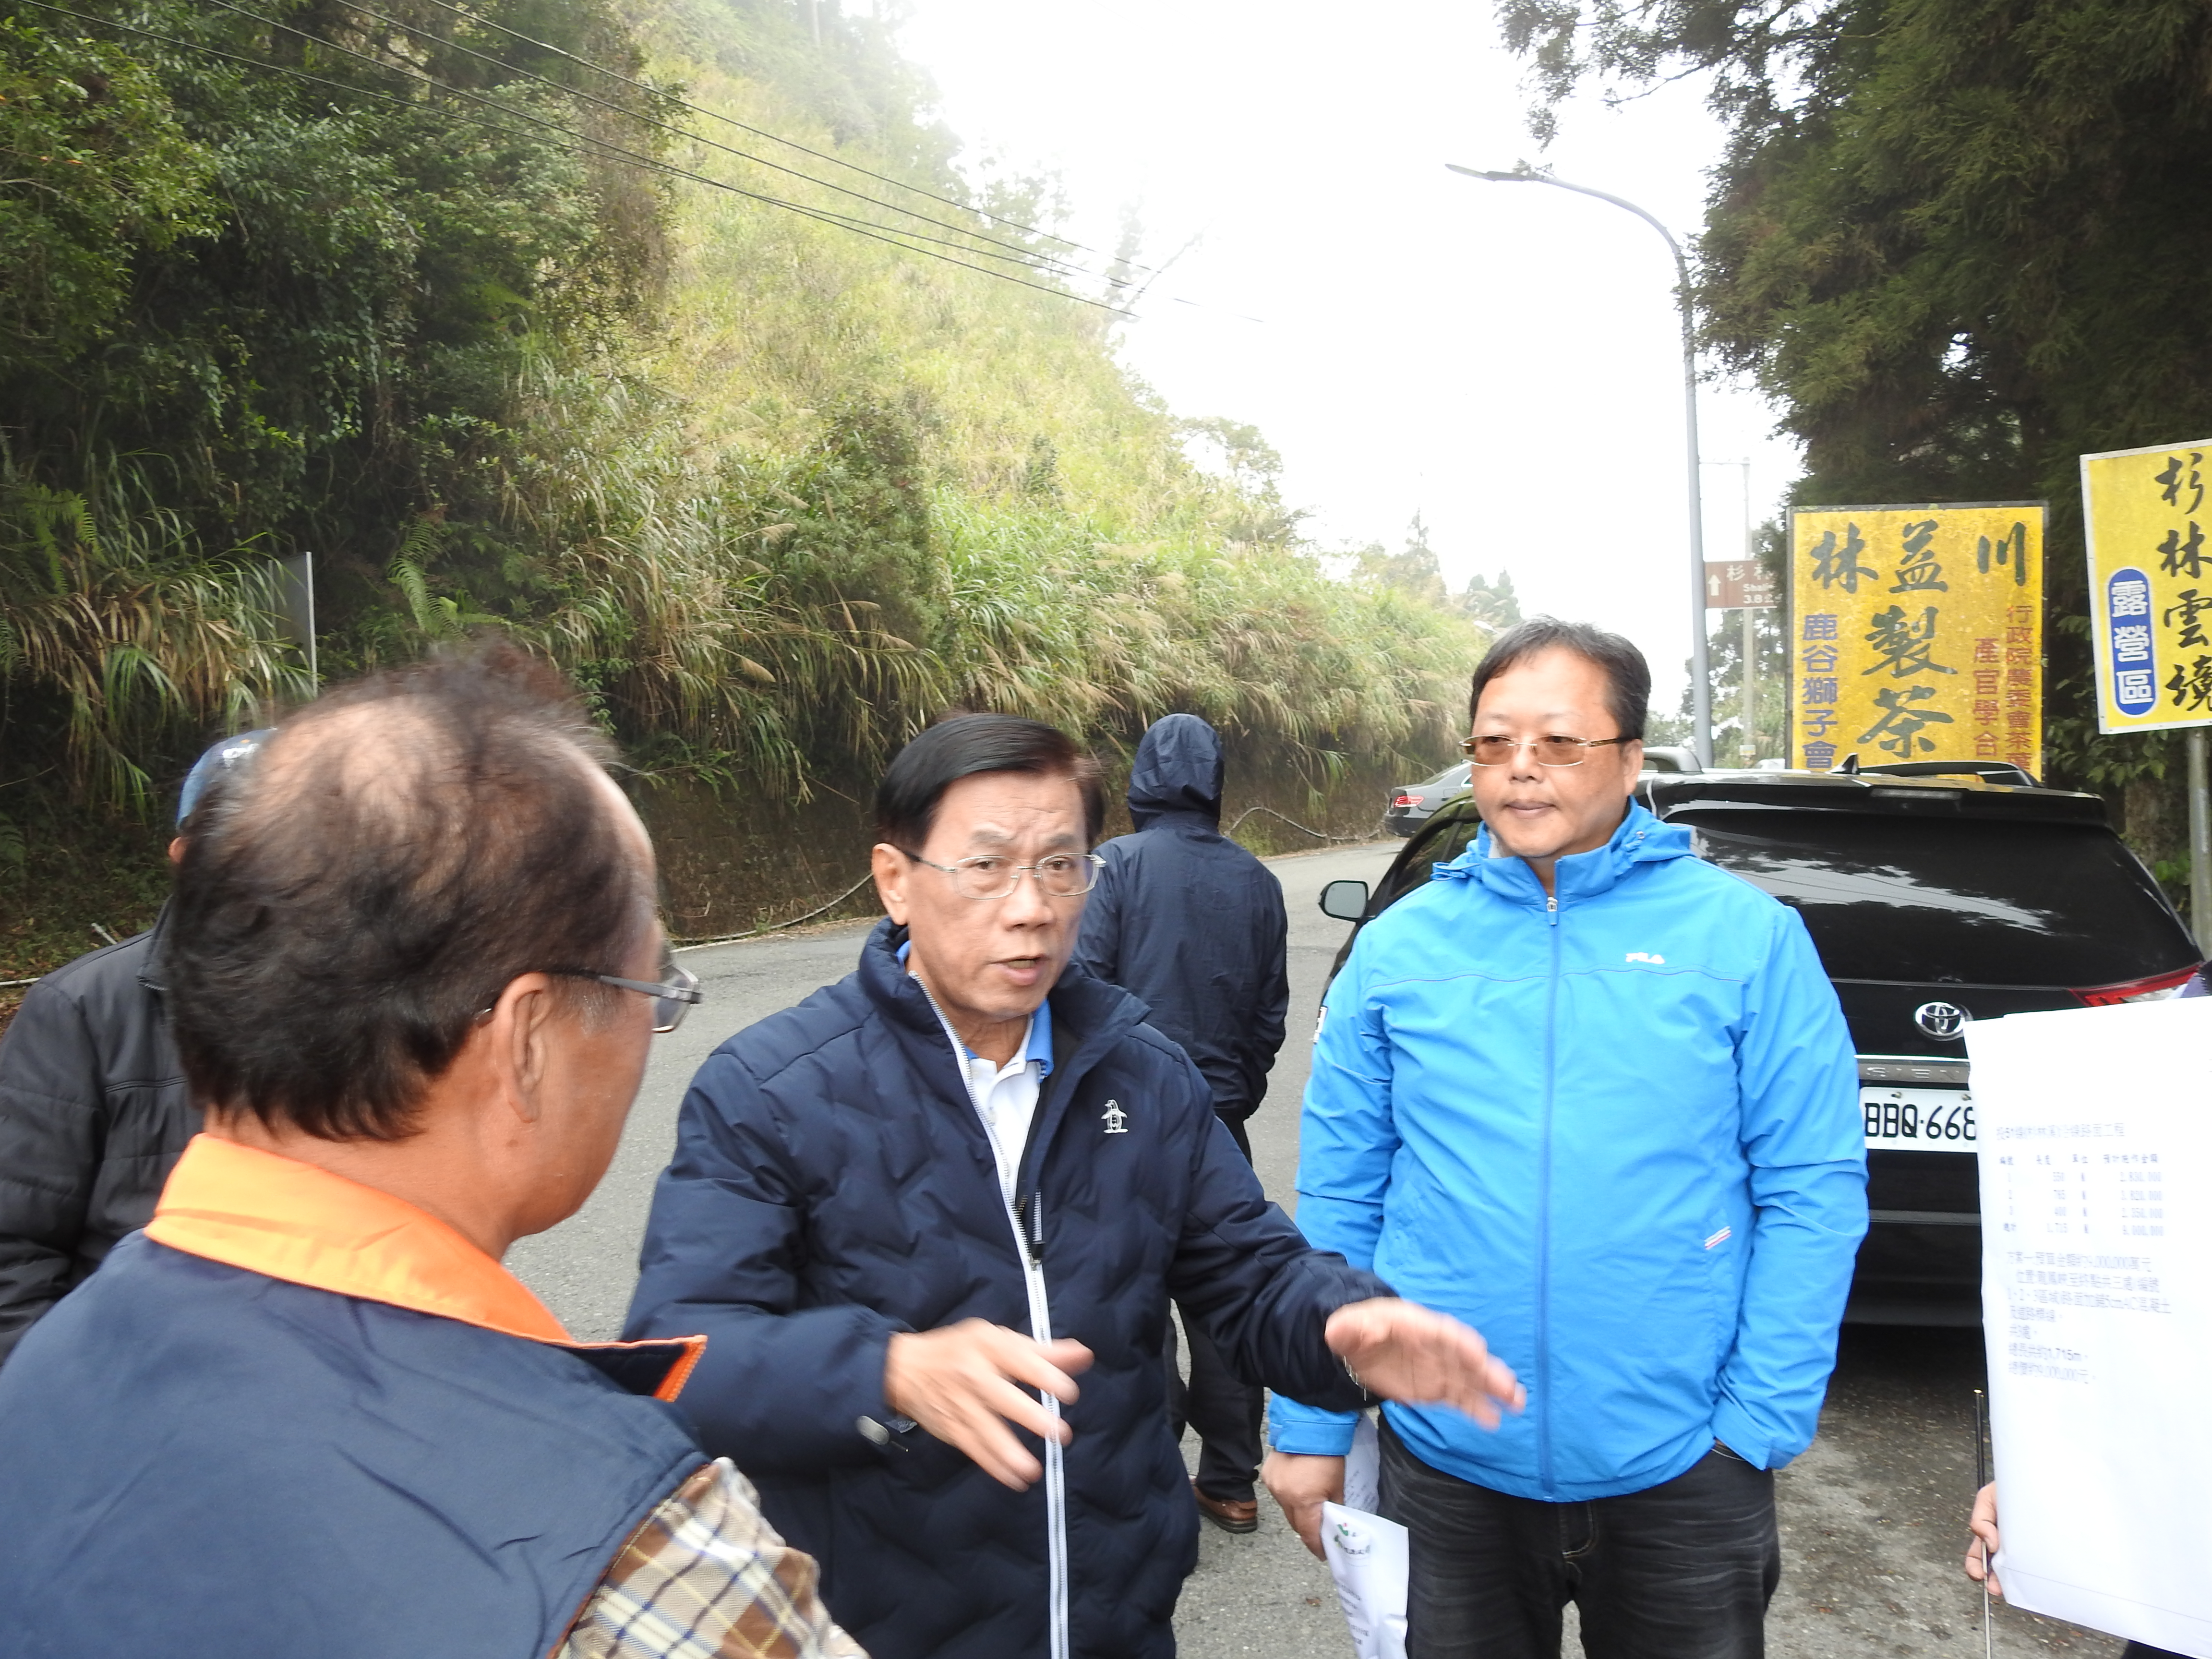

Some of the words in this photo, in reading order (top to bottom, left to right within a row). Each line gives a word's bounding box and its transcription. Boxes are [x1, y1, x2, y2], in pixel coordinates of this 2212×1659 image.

[1802, 613, 1838, 768] 鹿谷獅子會
[2111, 580, 2153, 704] 露營區
